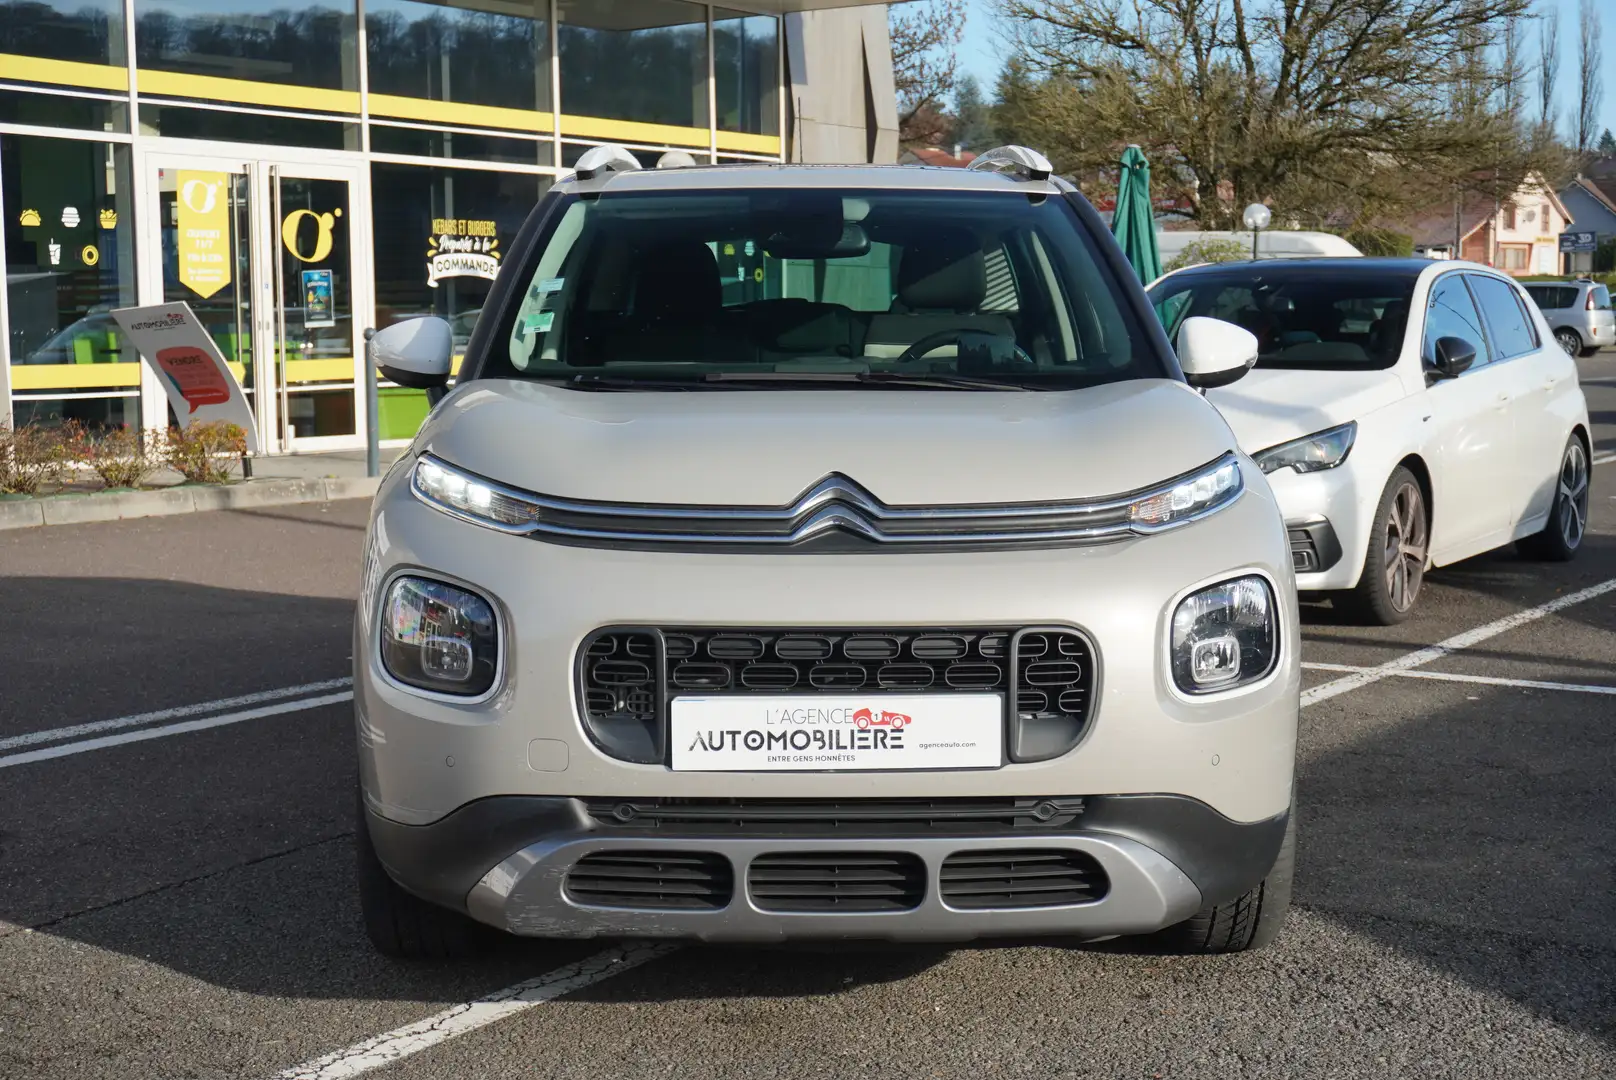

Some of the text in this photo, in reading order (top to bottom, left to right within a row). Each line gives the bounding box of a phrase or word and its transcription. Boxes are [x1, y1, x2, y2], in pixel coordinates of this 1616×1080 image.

[433, 219, 496, 236] KEBABS ET BURGERS
[474, 236, 481, 251] à
[436, 258, 495, 275] COMMANDE
[766, 708, 853, 724] L'AGENCE
[815, 753, 856, 762] HONNÊTES
